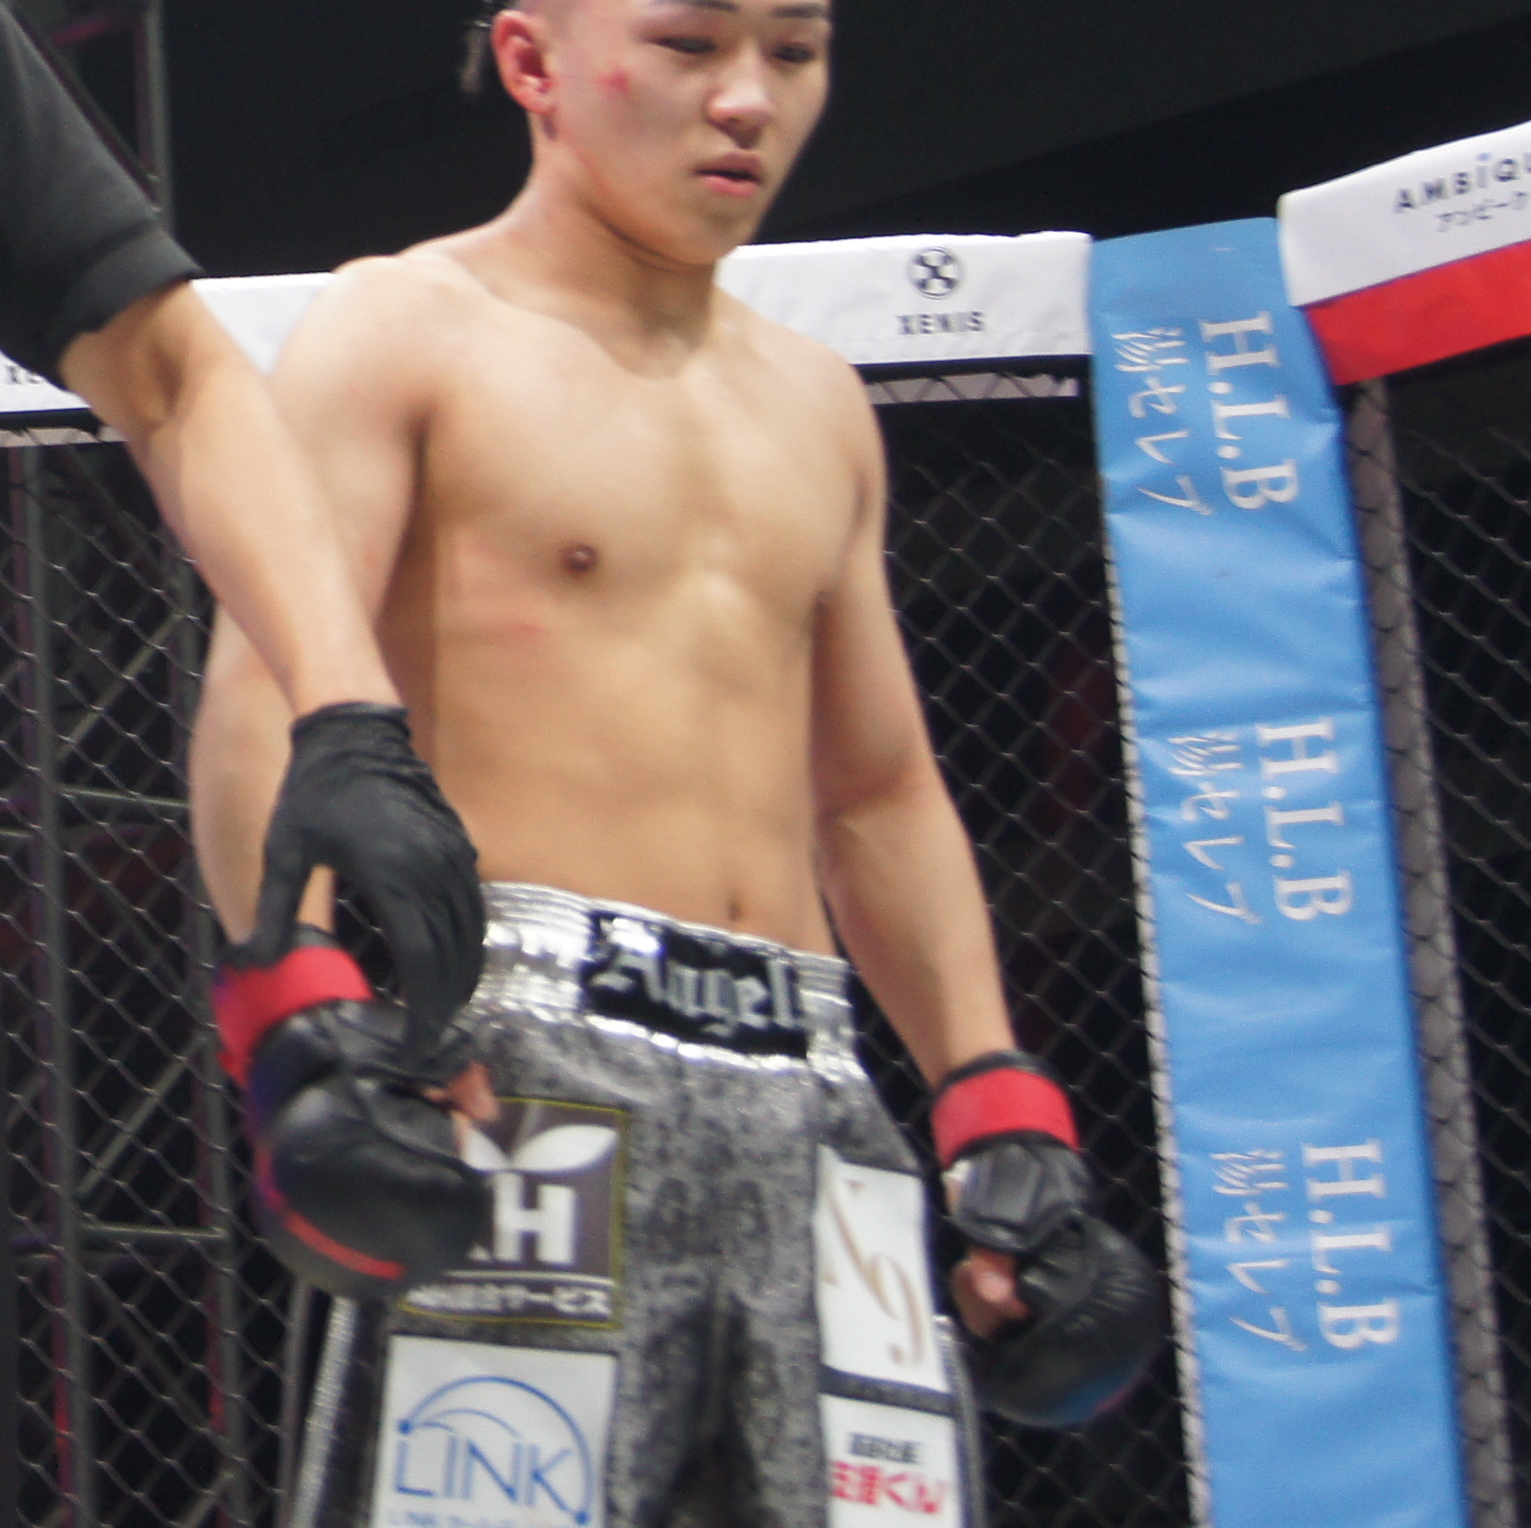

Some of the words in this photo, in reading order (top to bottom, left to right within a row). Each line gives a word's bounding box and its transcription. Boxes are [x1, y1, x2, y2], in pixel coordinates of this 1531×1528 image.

[896, 310, 986, 336] XENIS
[1198, 310, 1300, 510] H.L.B
[1254, 715, 1357, 921] H.L.B
[1300, 1137, 1401, 1349] H.L.B
[396, 1435, 575, 1509] LINK
